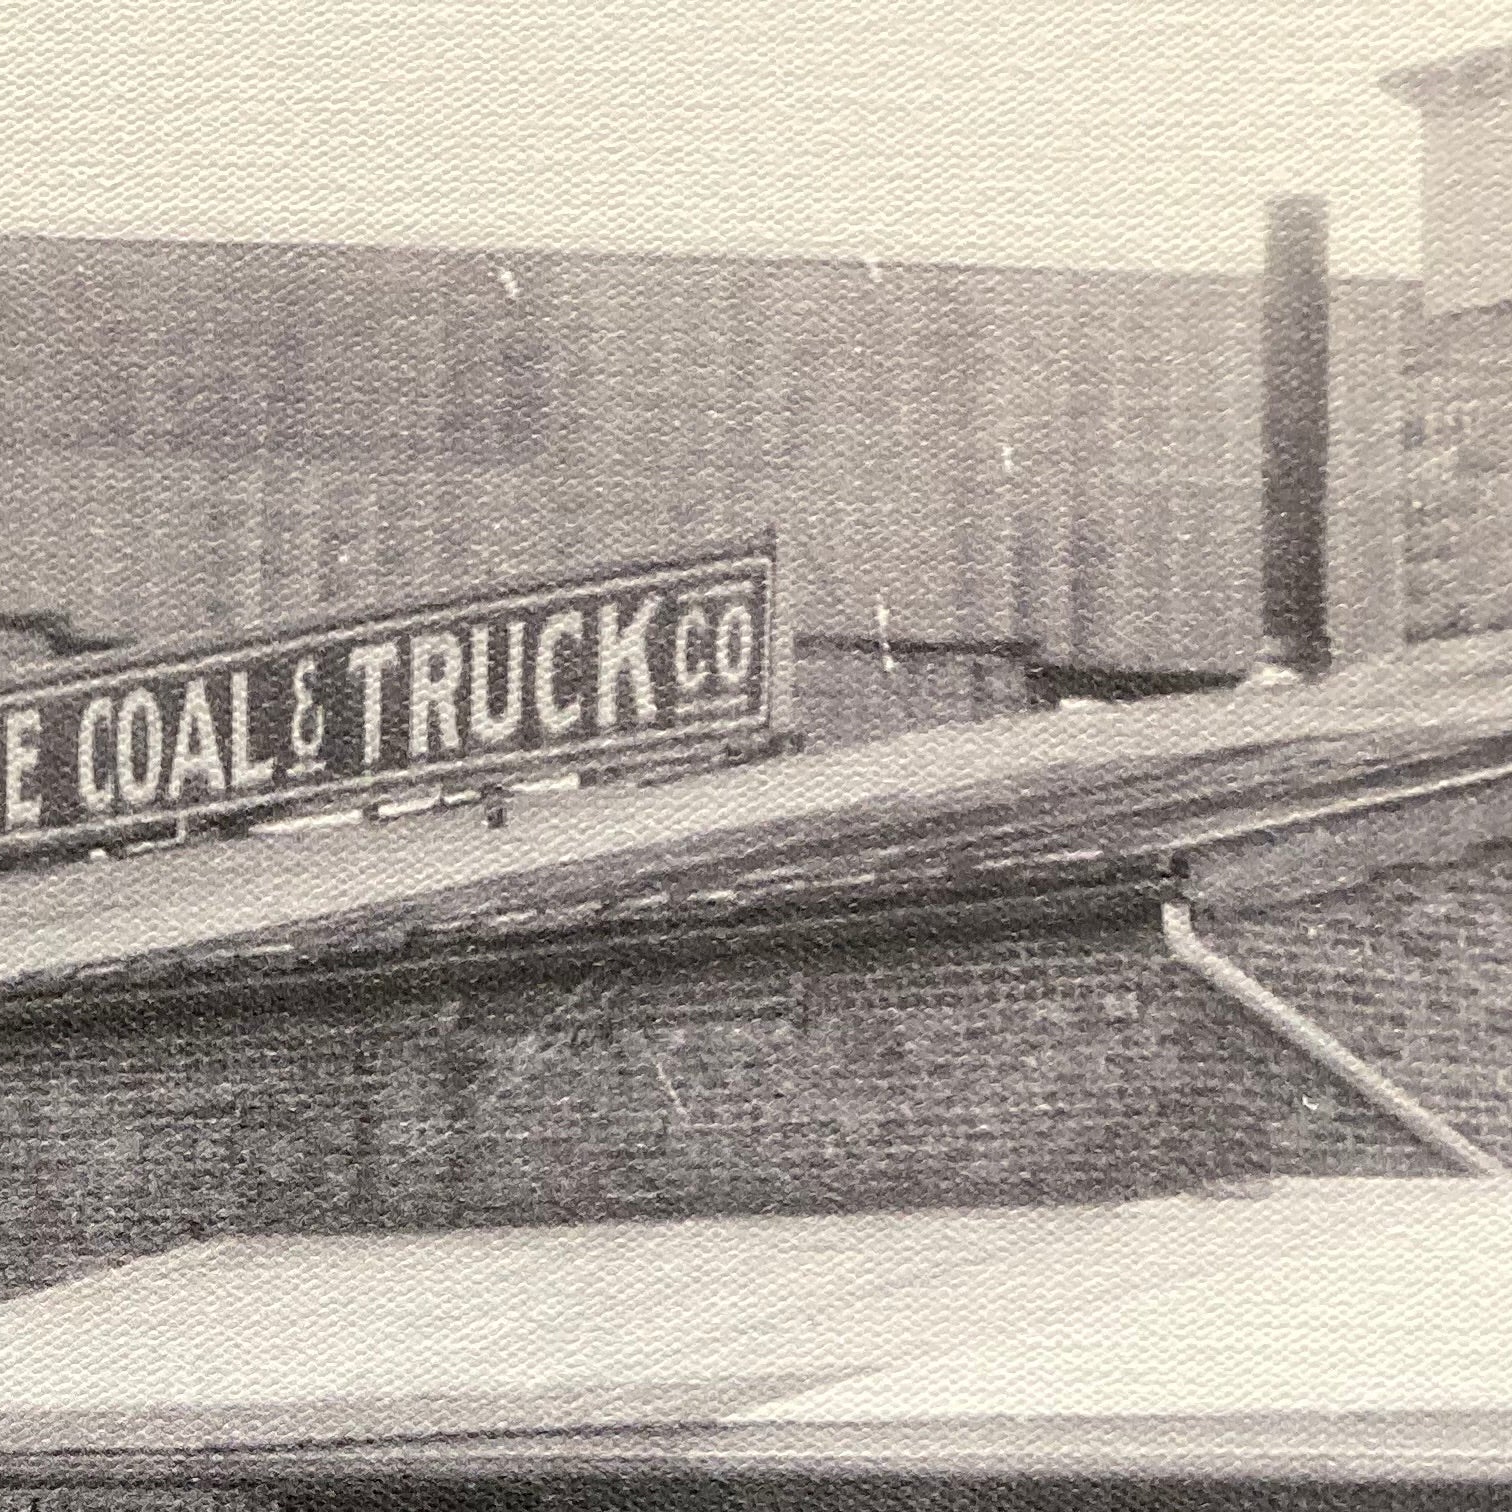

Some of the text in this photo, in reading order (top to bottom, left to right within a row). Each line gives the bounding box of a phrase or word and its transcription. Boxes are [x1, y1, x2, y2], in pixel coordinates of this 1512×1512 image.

[77, 673, 276, 813] COAL
[291, 657, 325, 758] &
[347, 593, 668, 768] TRUCK
[674, 602, 754, 690] CO
